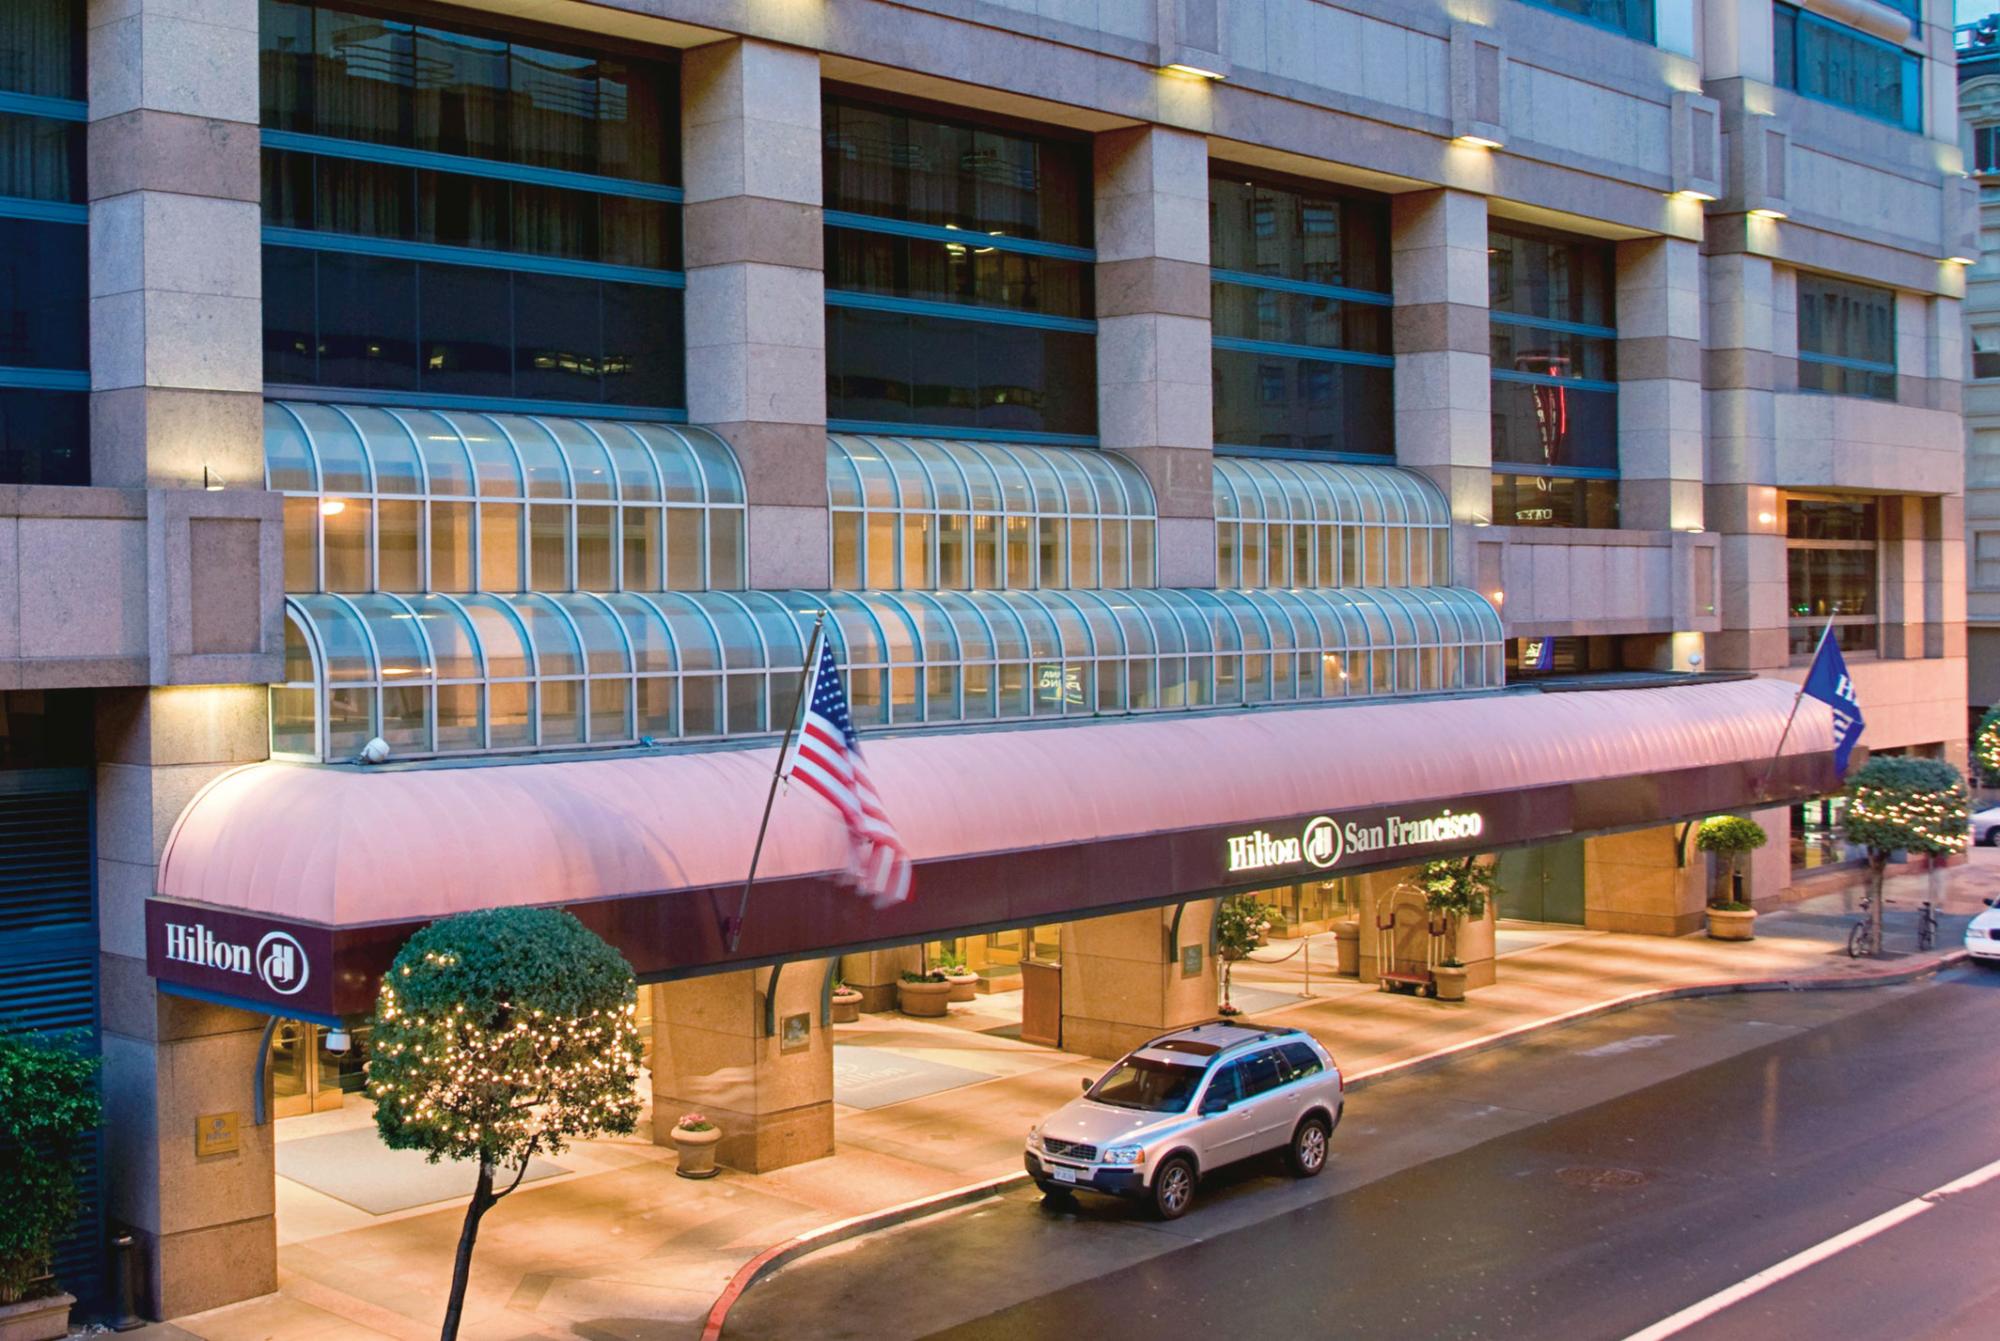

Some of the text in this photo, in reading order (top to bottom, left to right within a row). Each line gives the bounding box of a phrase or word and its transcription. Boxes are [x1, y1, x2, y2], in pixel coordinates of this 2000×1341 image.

[1227, 830, 1301, 872] Hilton
[1345, 822, 1384, 854] San
[1387, 809, 1482, 846] Francisco
[165, 923, 252, 975] Hilton
